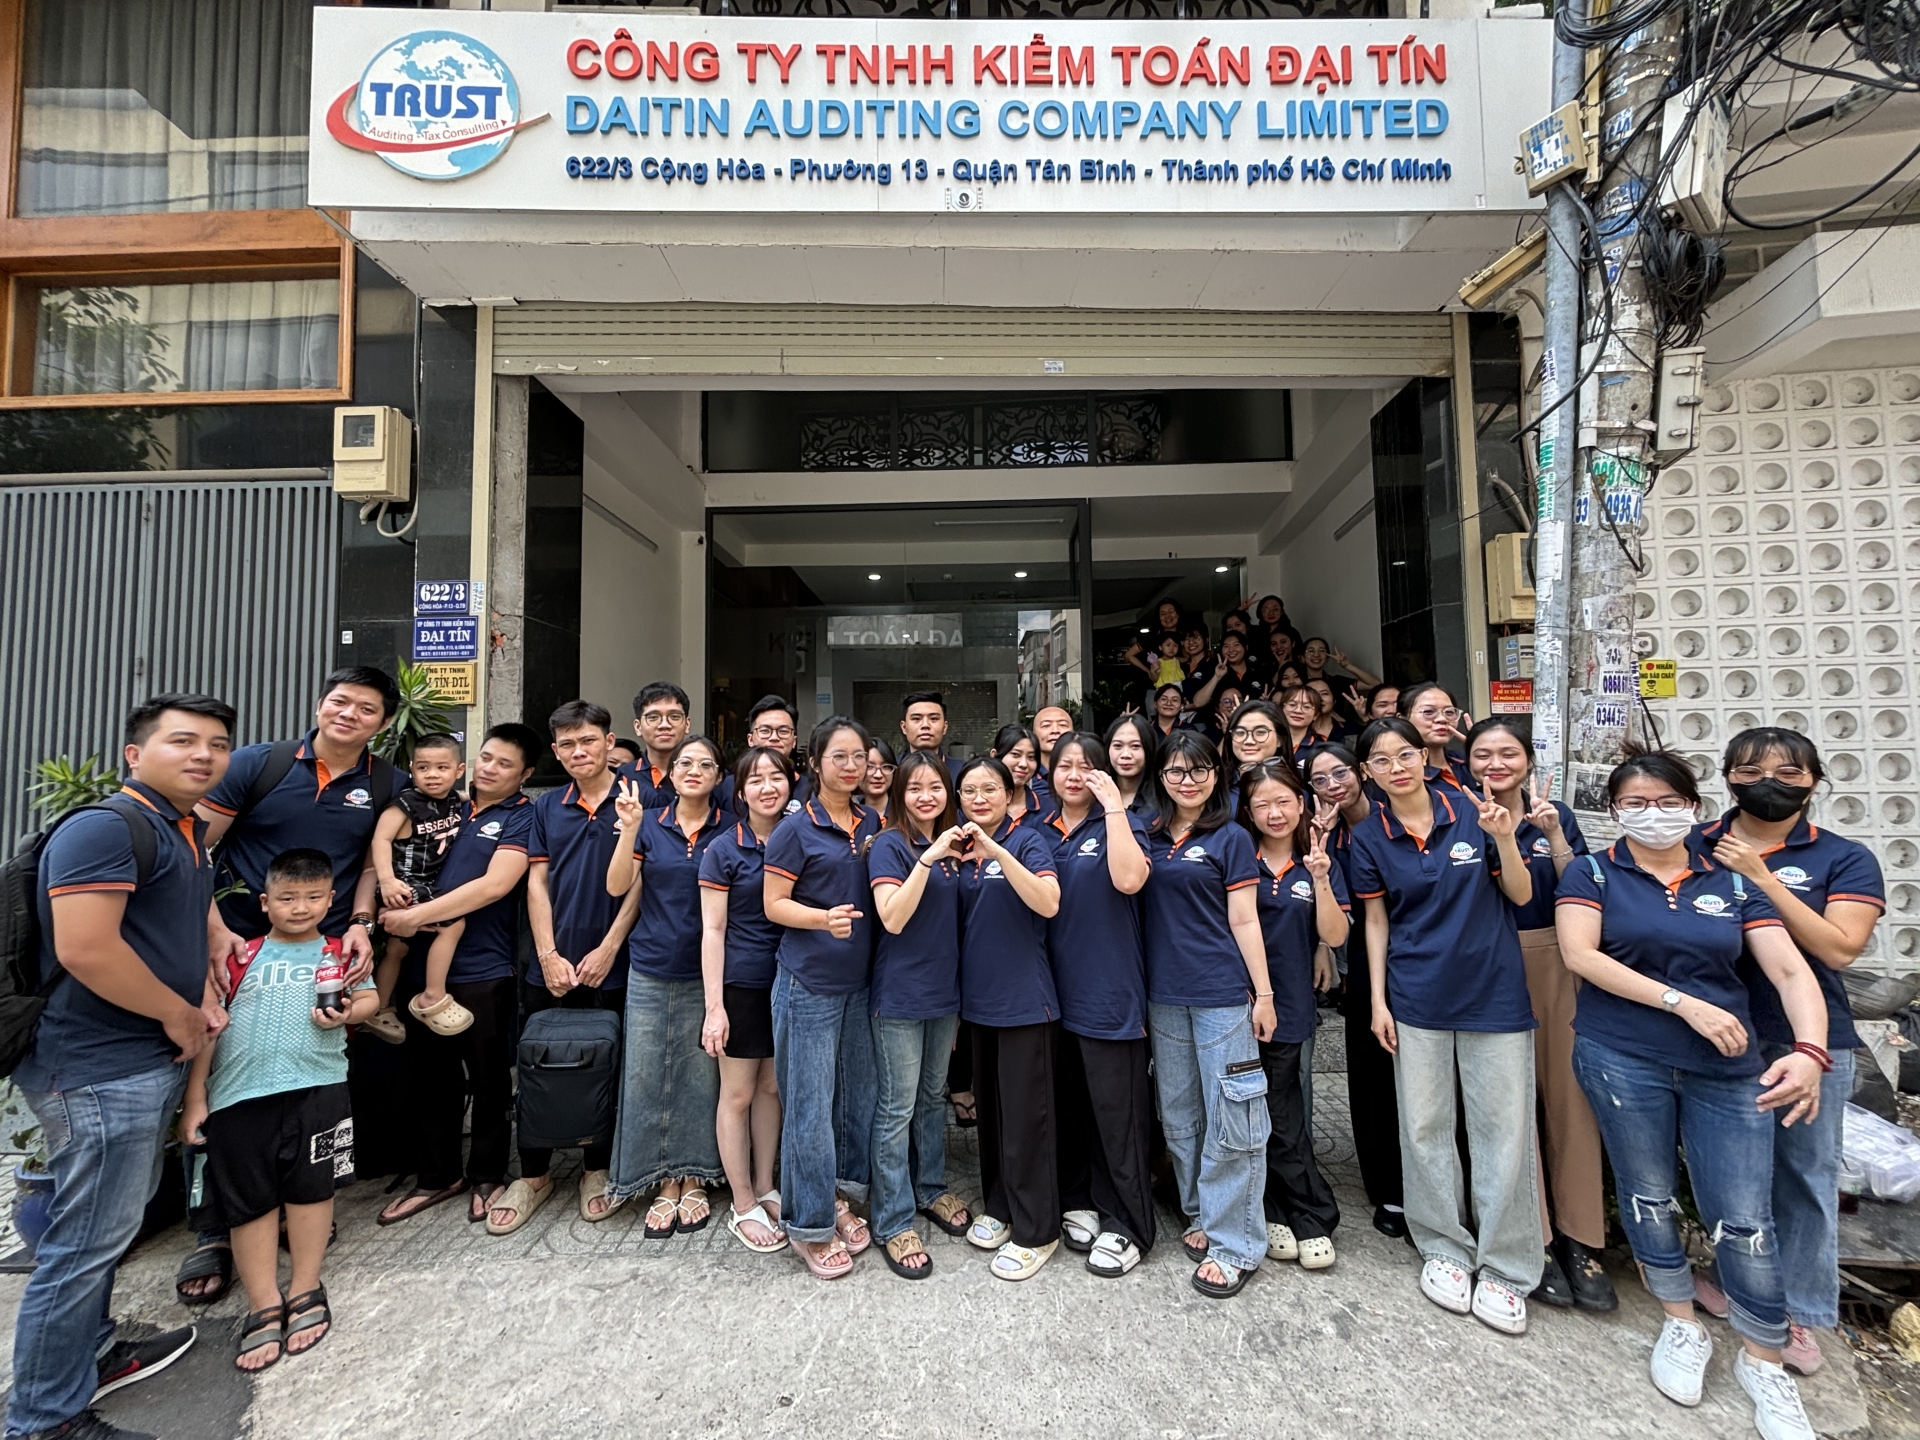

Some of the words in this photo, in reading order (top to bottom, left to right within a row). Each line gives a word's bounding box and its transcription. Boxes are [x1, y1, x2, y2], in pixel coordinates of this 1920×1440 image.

[567, 28, 720, 82] CÔNG
[737, 43, 802, 84] TY
[816, 44, 953, 85] TNHH
[974, 33, 1095, 85] KIỂM
[1111, 37, 1250, 86] TOÁN
[1266, 45, 1352, 94] ĐẠI
[1367, 34, 1446, 85] TÍN
[369, 82, 503, 120] TRUST
[368, 126, 414, 143] Auditing
[423, 130, 441, 141] Tax
[442, 121, 499, 139] Consulting
[566, 95, 729, 136] DAITIN
[744, 98, 980, 138] AUDITING
[998, 100, 1242, 139] COMPANY
[1257, 99, 1449, 138] LIMITED
[566, 156, 633, 180] 622/3
[641, 157, 708, 184] Cộng
[717, 158, 765, 180] Hòa
[902, 159, 928, 180] 13
[953, 159, 1018, 185] Quận
[1026, 159, 1071, 180] Tân
[1247, 156, 1293, 186] phố
[1342, 158, 1387, 180] Chí
[1391, 158, 1451, 181] Minh
[420, 584, 465, 602] 622/3
[420, 630, 445, 644] ĐẠI
[447, 627, 471, 642] TÍN
